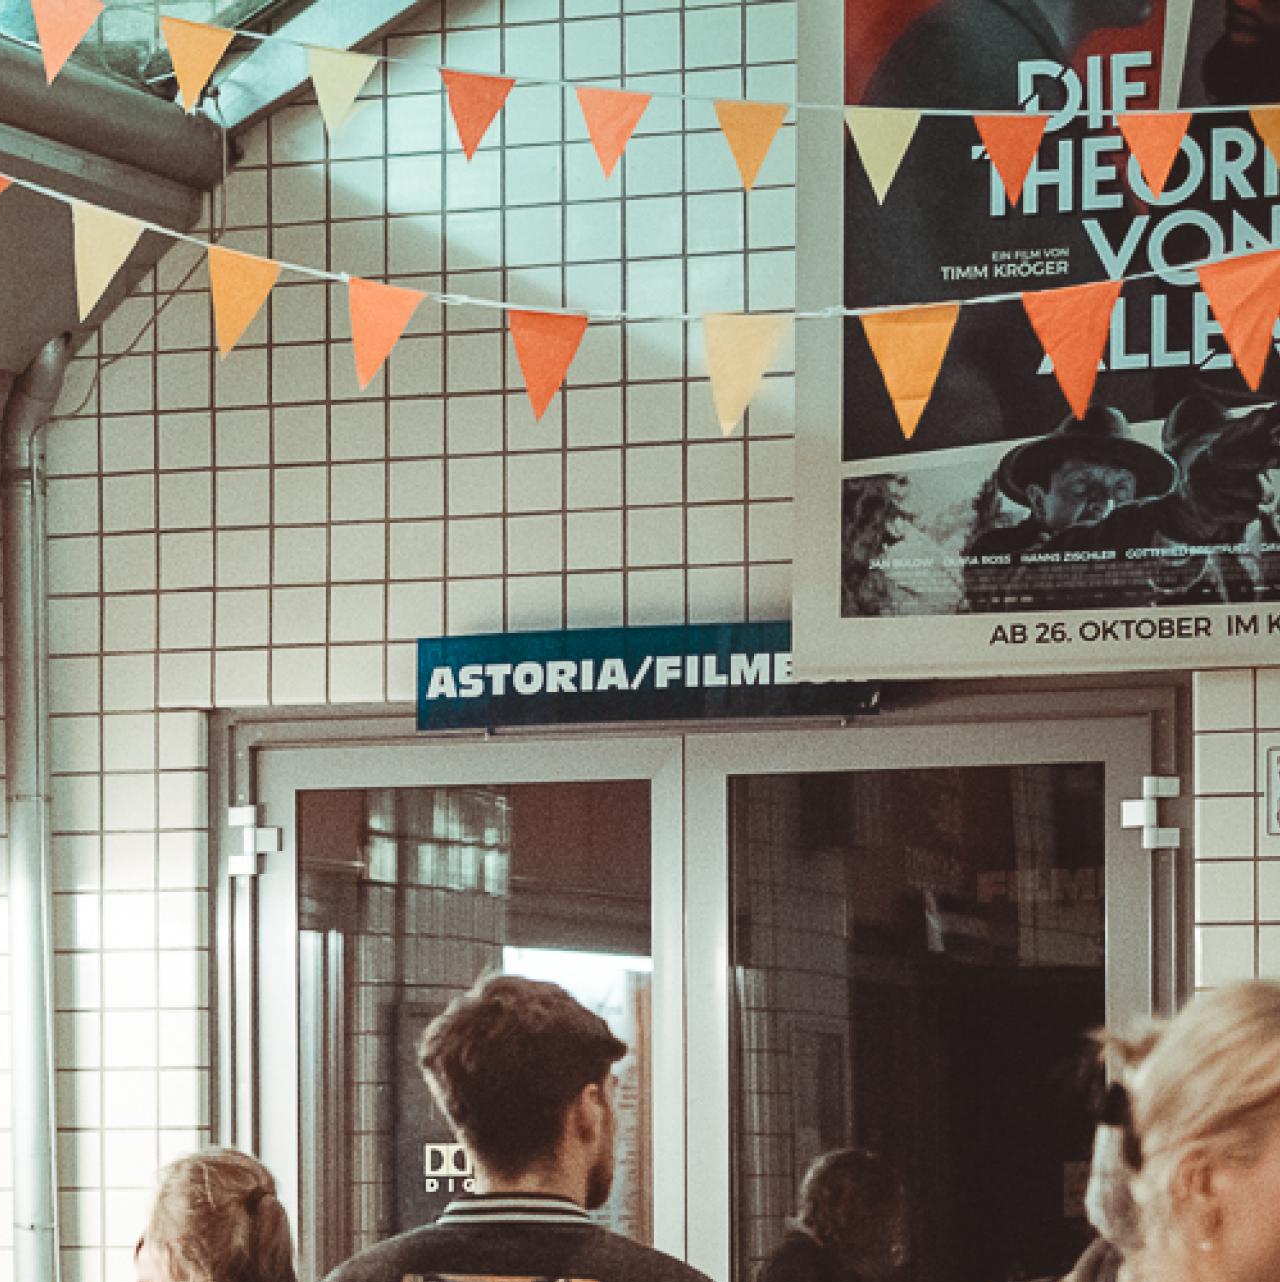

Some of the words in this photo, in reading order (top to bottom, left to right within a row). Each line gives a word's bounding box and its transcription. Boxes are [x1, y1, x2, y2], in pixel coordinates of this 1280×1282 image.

[1017, 51, 1152, 134] DIE
[941, 264, 988, 281] TIMM
[994, 259, 1070, 279] KRÖGER
[990, 623, 1028, 645] AB
[1035, 622, 1072, 644] 26.
[1079, 617, 1212, 642] OKTOBER
[1228, 614, 1259, 636] IM
[425, 652, 793, 699] ASTORIA/FILME
